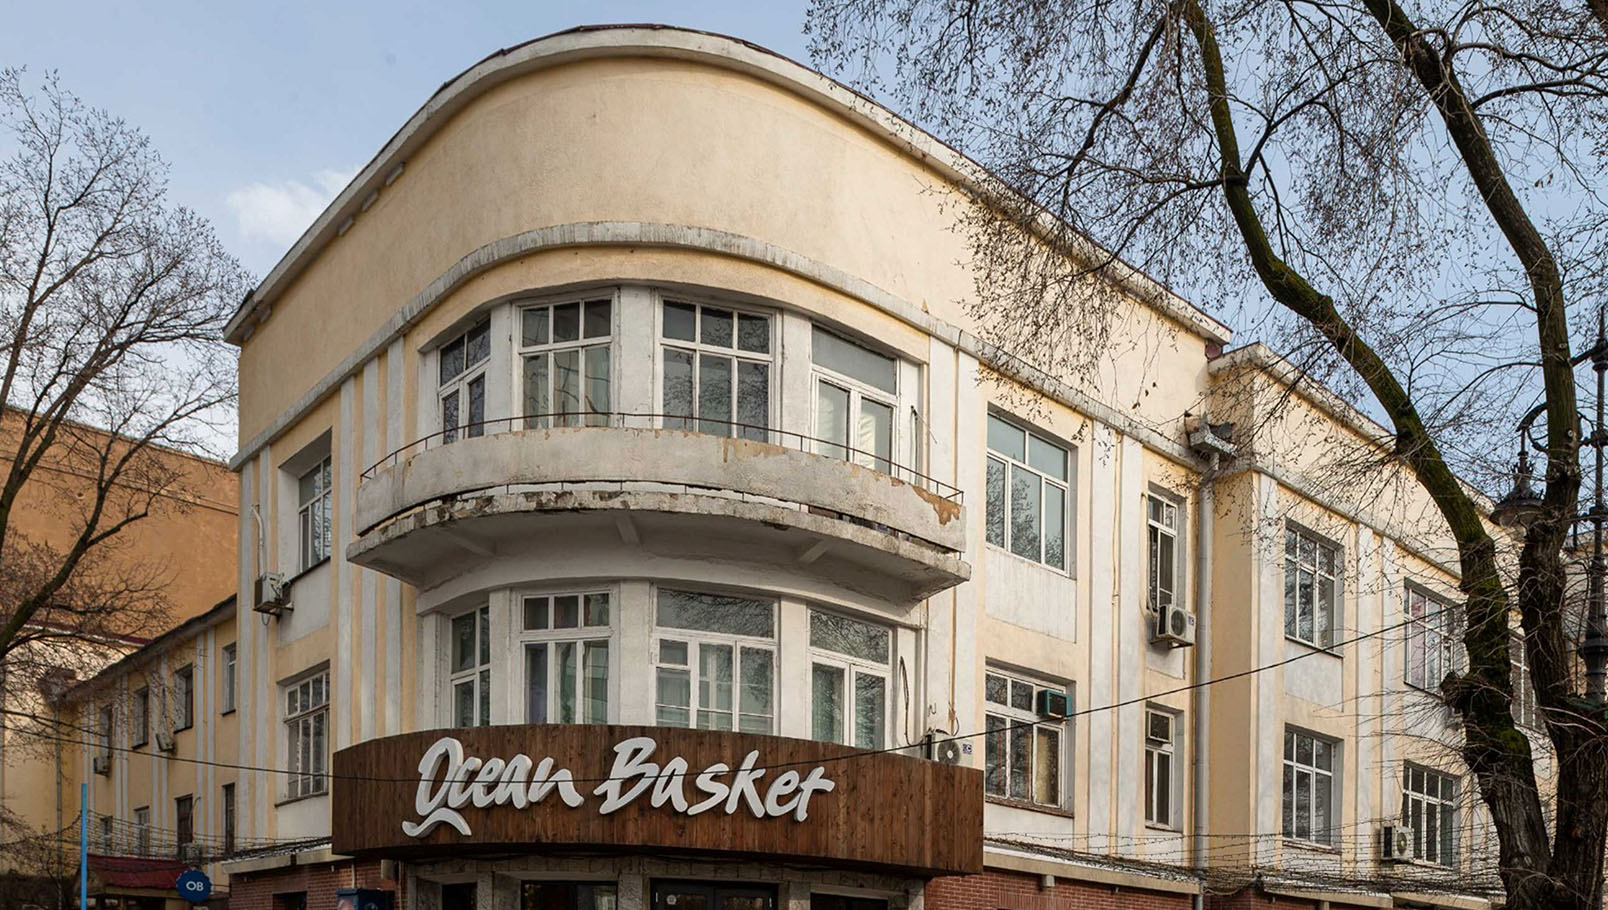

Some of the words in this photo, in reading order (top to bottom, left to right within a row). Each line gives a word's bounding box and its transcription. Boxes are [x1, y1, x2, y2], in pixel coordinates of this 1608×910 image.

[402, 737, 585, 837] Ocean
[593, 737, 836, 822] Basket
[186, 881, 204, 892] OB
